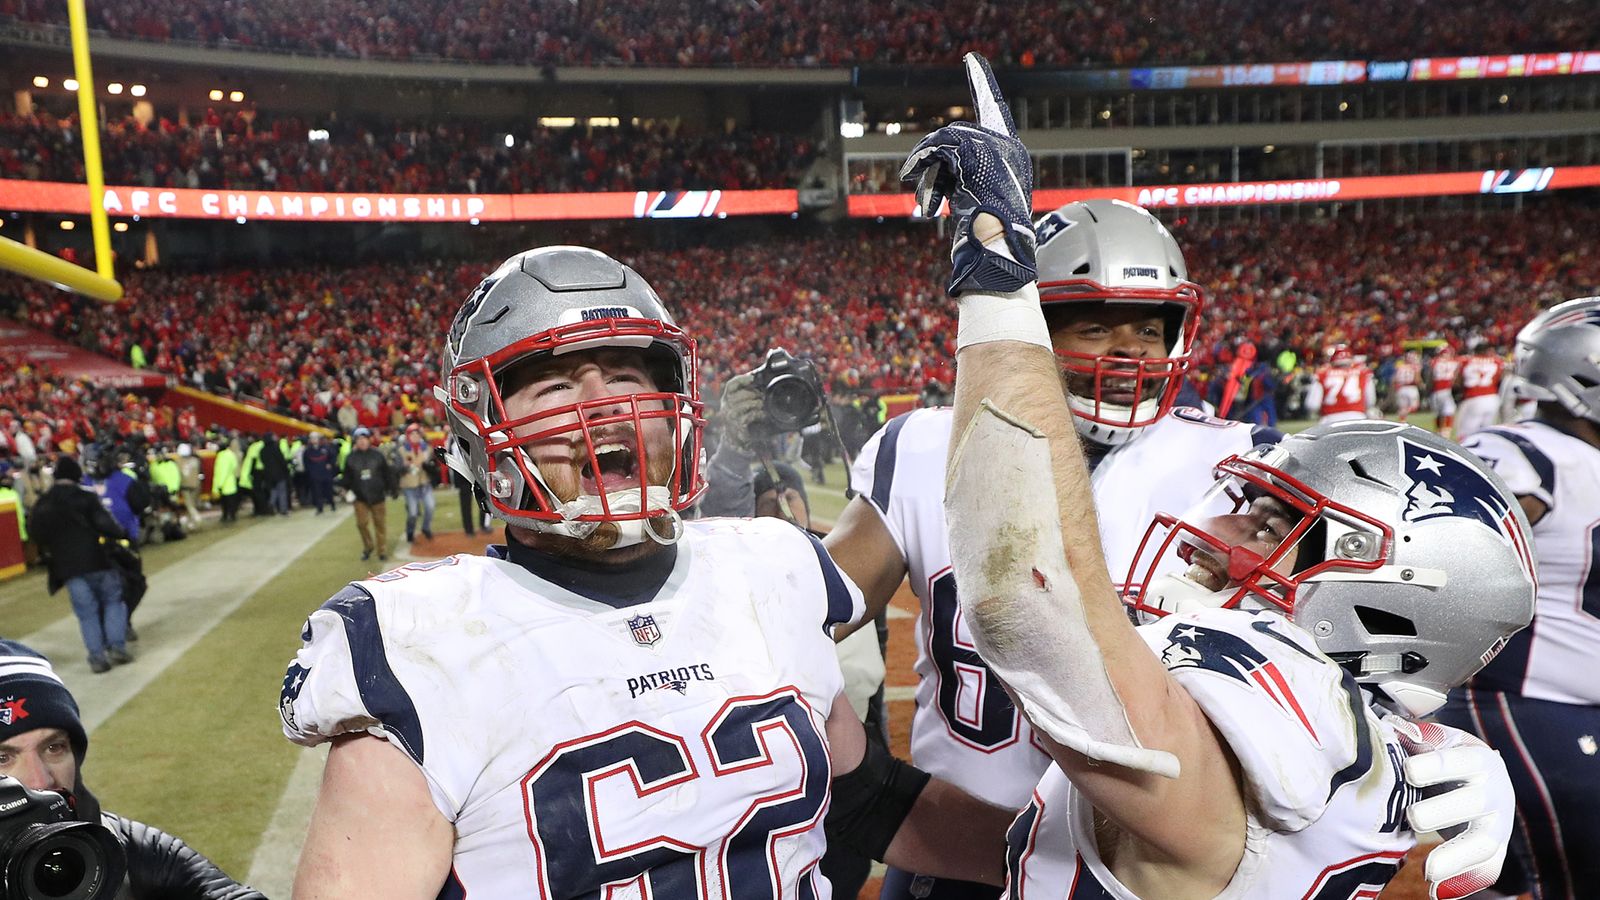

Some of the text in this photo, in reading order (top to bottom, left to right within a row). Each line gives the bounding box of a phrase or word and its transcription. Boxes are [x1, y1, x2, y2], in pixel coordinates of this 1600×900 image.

[103, 190, 485, 217] AFC CHAMPIONSHIP
[1137, 181, 1340, 206] AFC CHAMPIONSHIP
[1324, 376, 1362, 404] 74
[634, 626, 659, 642] NFL
[928, 565, 1042, 757] 6
[626, 663, 715, 699] PATRIOTS
[0, 797, 28, 811] Canon
[520, 685, 832, 900] 62
